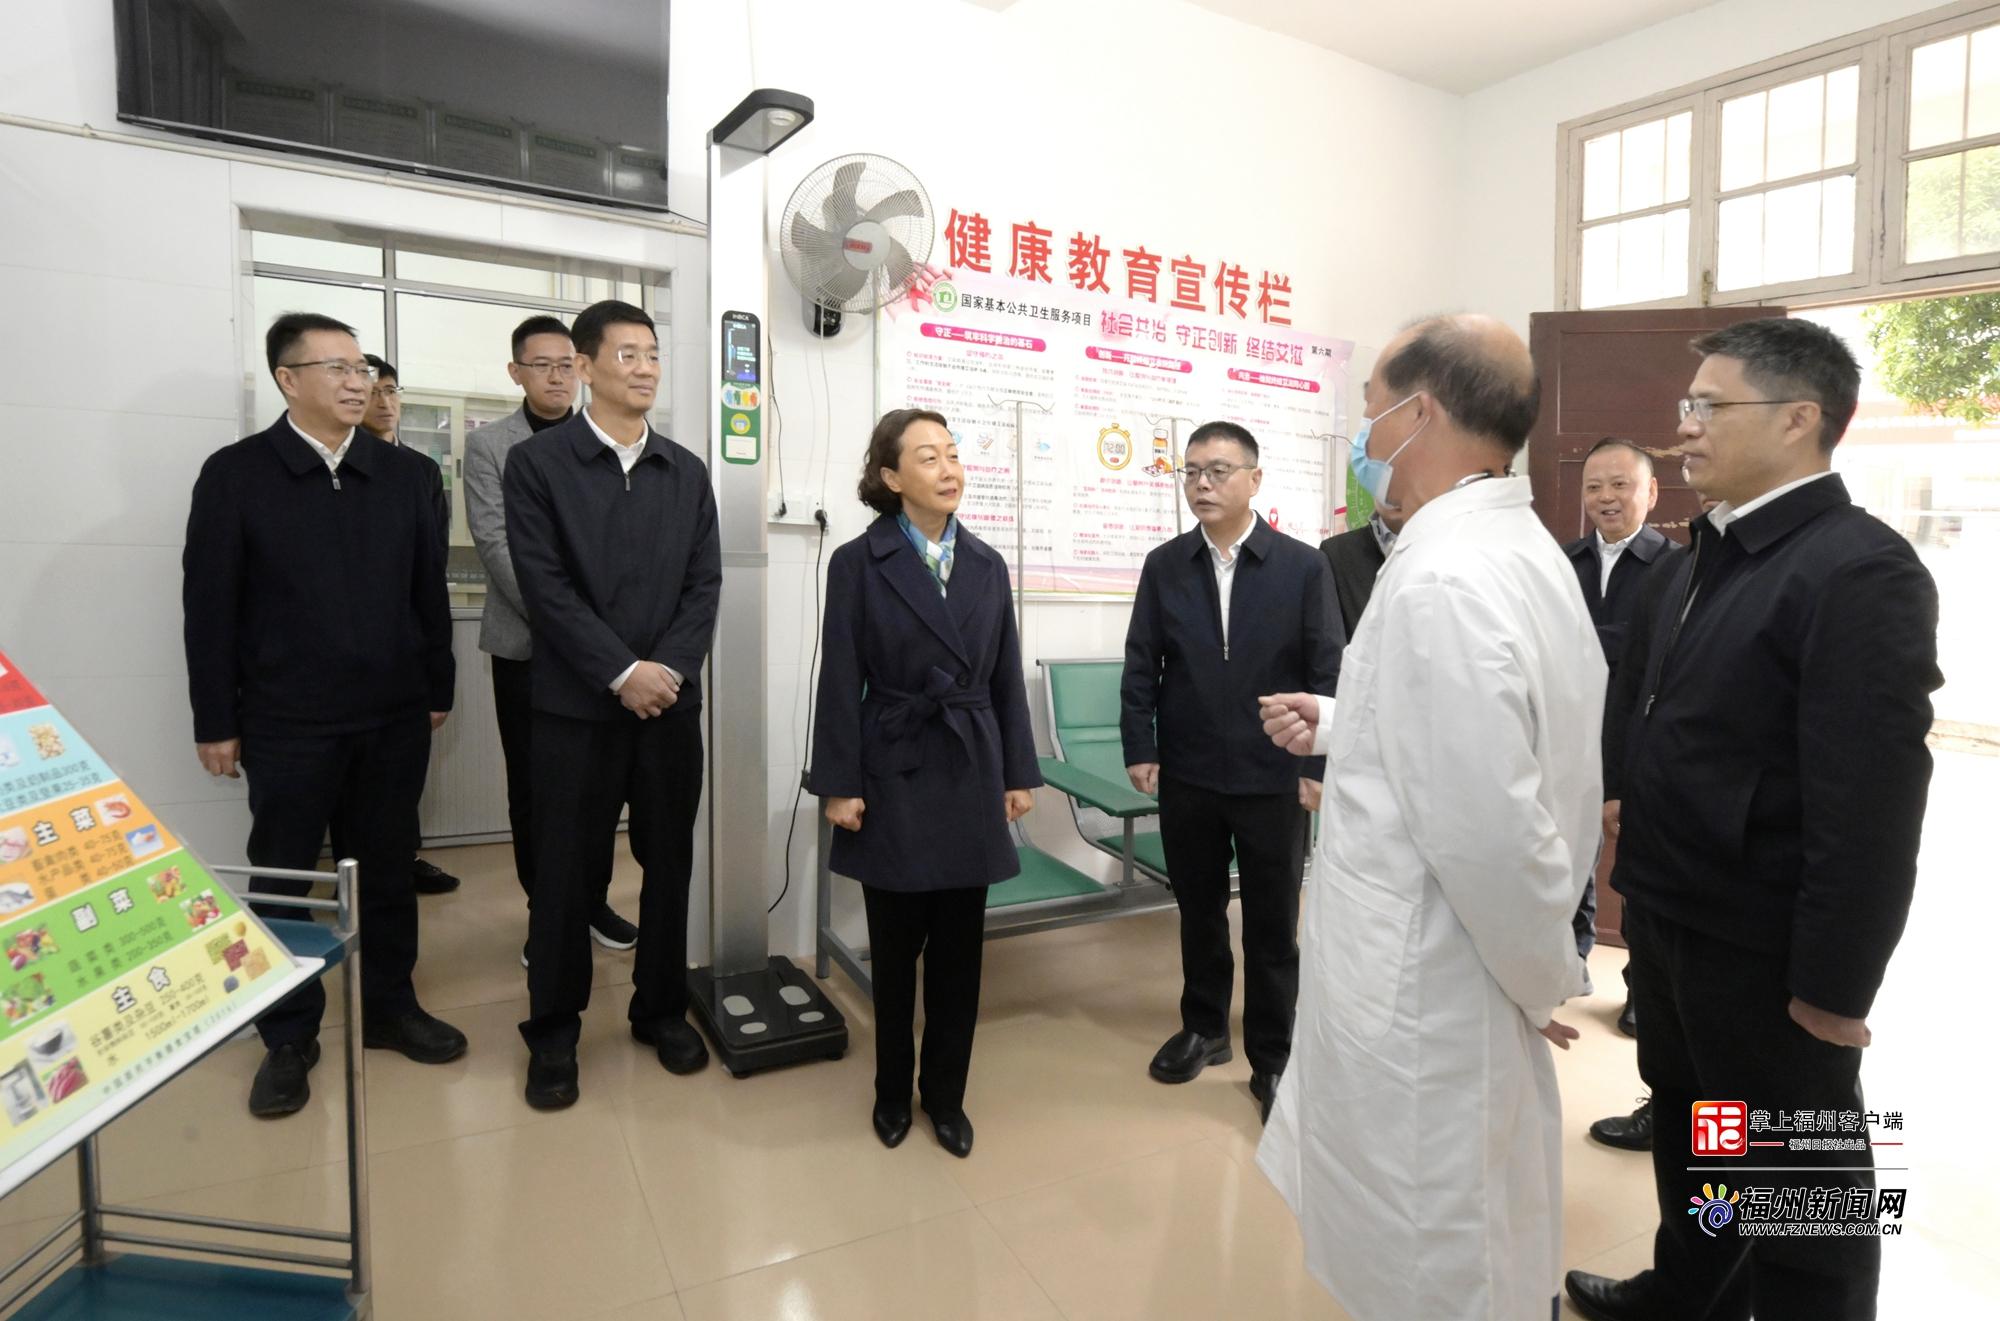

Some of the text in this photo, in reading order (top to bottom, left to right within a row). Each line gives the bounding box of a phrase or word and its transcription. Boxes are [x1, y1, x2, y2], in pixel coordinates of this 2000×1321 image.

[944, 208, 1292, 326] 健康教育宣传栏
[961, 293, 1092, 327] 国家基本公共卫生服务项目
[1101, 309, 1167, 343] 社会共治
[1176, 324, 1238, 355] 守正创新
[1245, 336, 1304, 366] 终结艾滋
